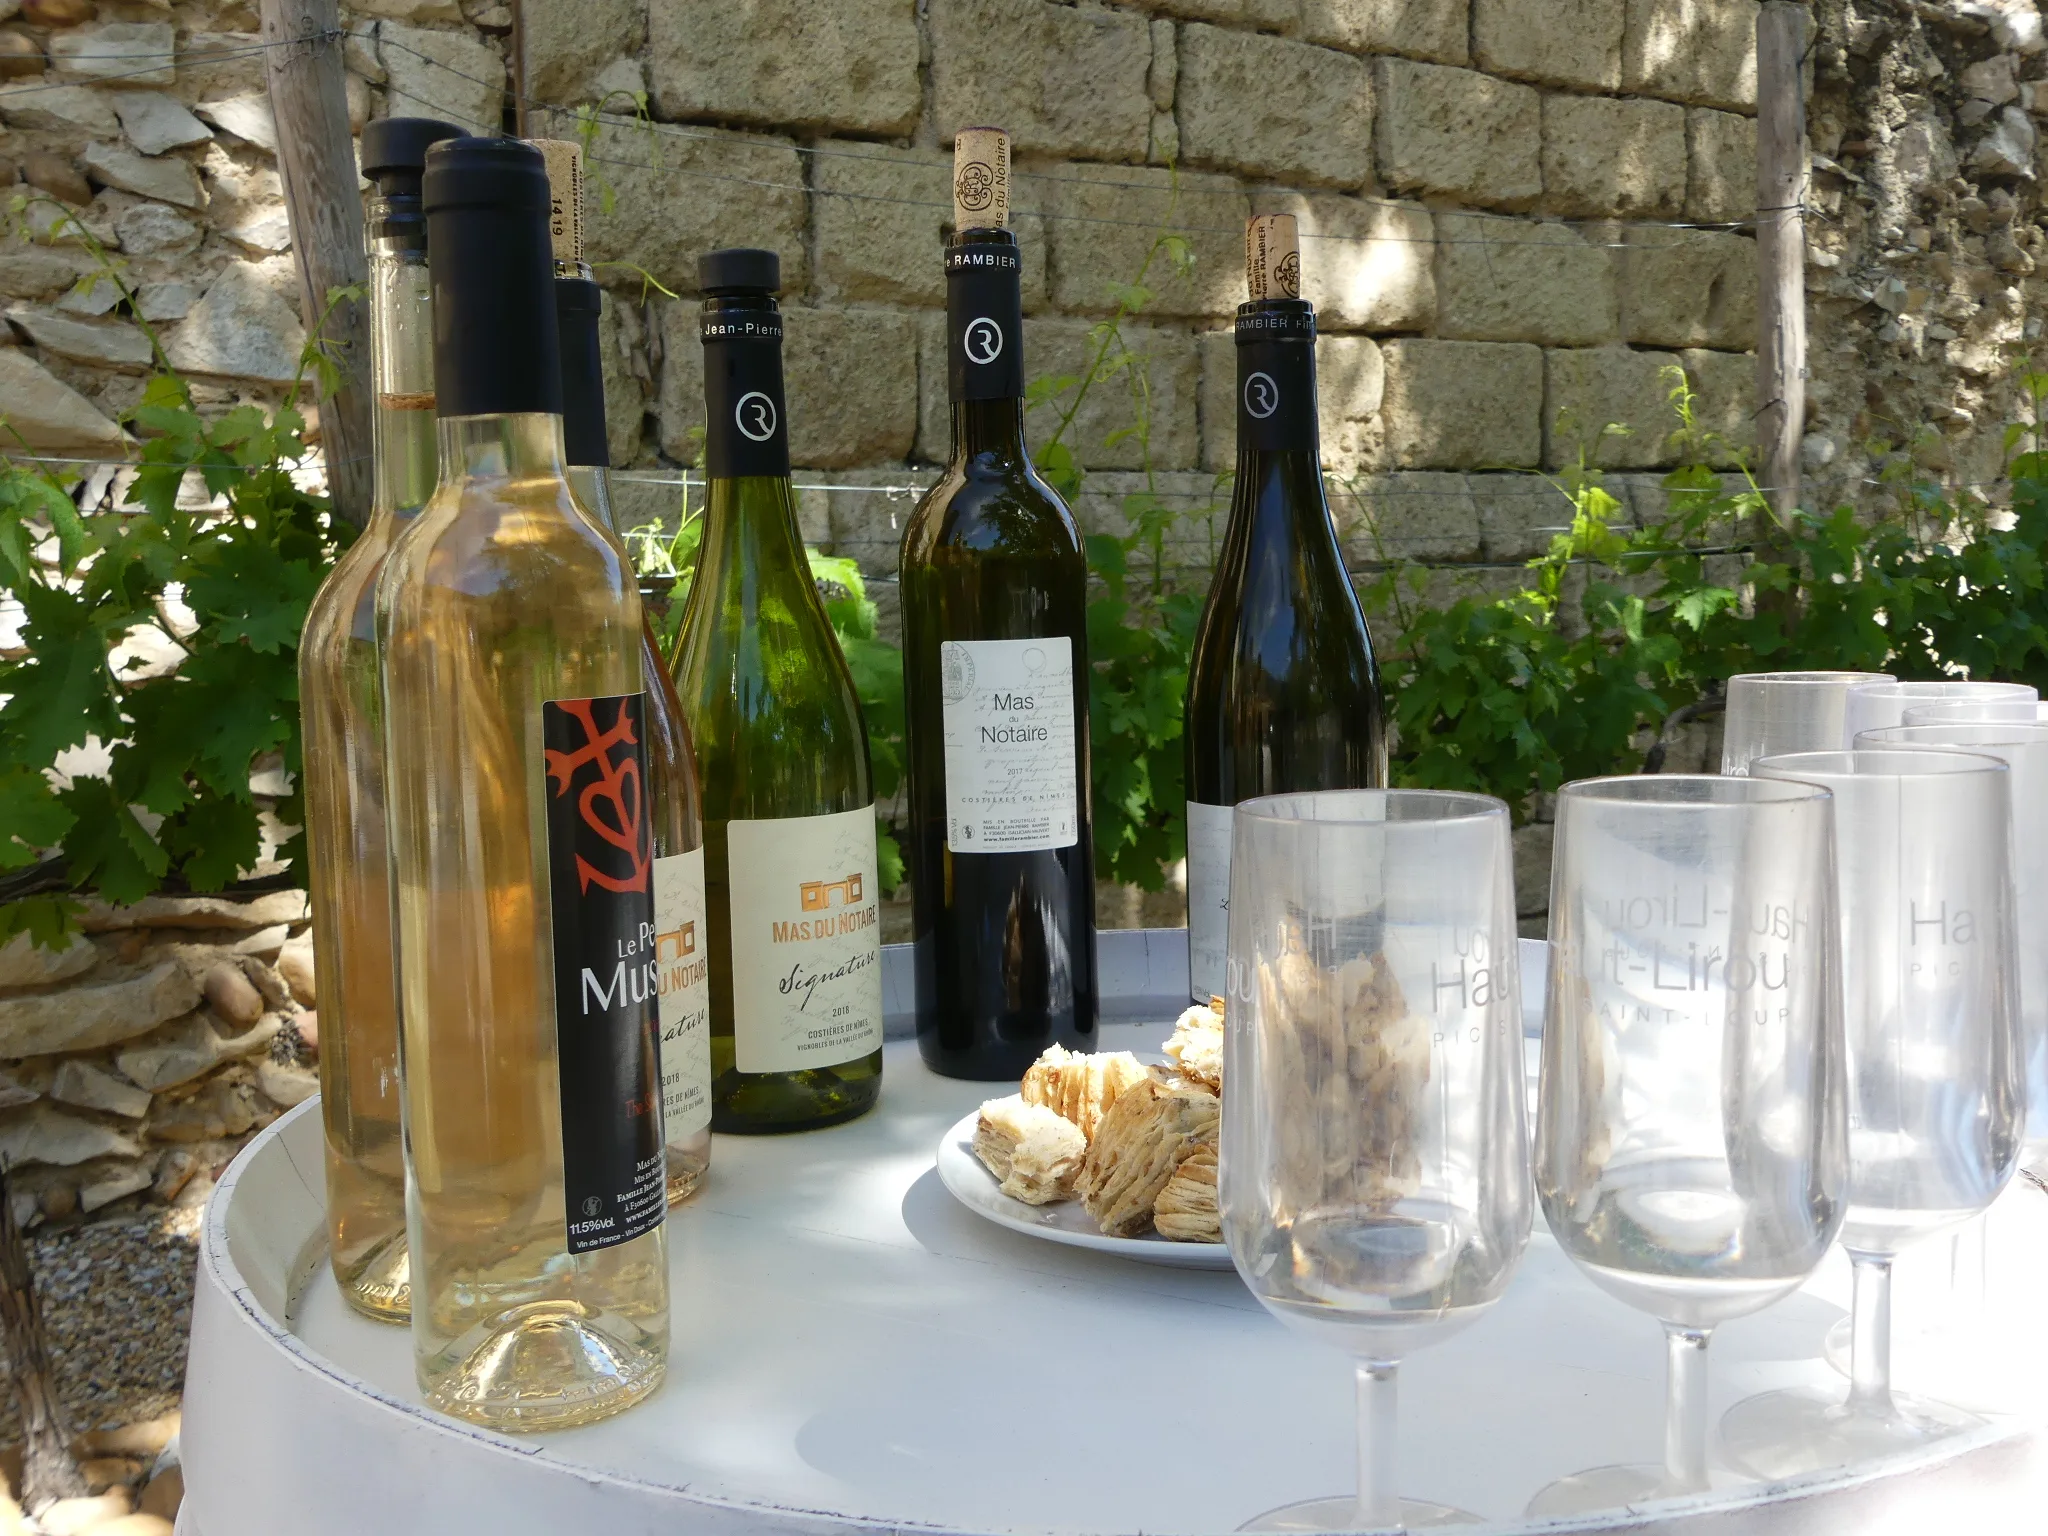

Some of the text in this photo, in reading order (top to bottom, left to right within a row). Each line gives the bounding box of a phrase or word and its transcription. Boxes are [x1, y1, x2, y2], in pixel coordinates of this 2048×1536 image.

[995, 138, 1006, 228] as du Notaire
[1258, 226, 1266, 270] RAMBIER
[954, 254, 1016, 268] RAMBIER
[1253, 259, 1261, 295] Famille
[705, 323, 782, 337] Jean-Pierre
[1236, 318, 1287, 332] RAMBIER
[994, 693, 1034, 711] Mas
[981, 725, 1048, 743] Notaire
[773, 904, 876, 944] MAS DU NOTAIRE
[618, 938, 636, 958] Le
[779, 949, 876, 1012] Signature
[832, 1006, 850, 1018] 2018
[808, 1025, 845, 1039] COSTIÈRES
[846, 1023, 852, 1032] DE
[798, 1041, 828, 1051] VIGNOBLES
[661, 1072, 680, 1086] 2018
[675, 1092, 683, 1104] DE
[637, 1159, 650, 1172] MAS
[617, 1187, 643, 1203] FAMILLE
[577, 1241, 588, 1249] Vin
[600, 1233, 621, 1244] France
[625, 1229, 634, 1237] Vin
[634, 1224, 646, 1234] Doux
